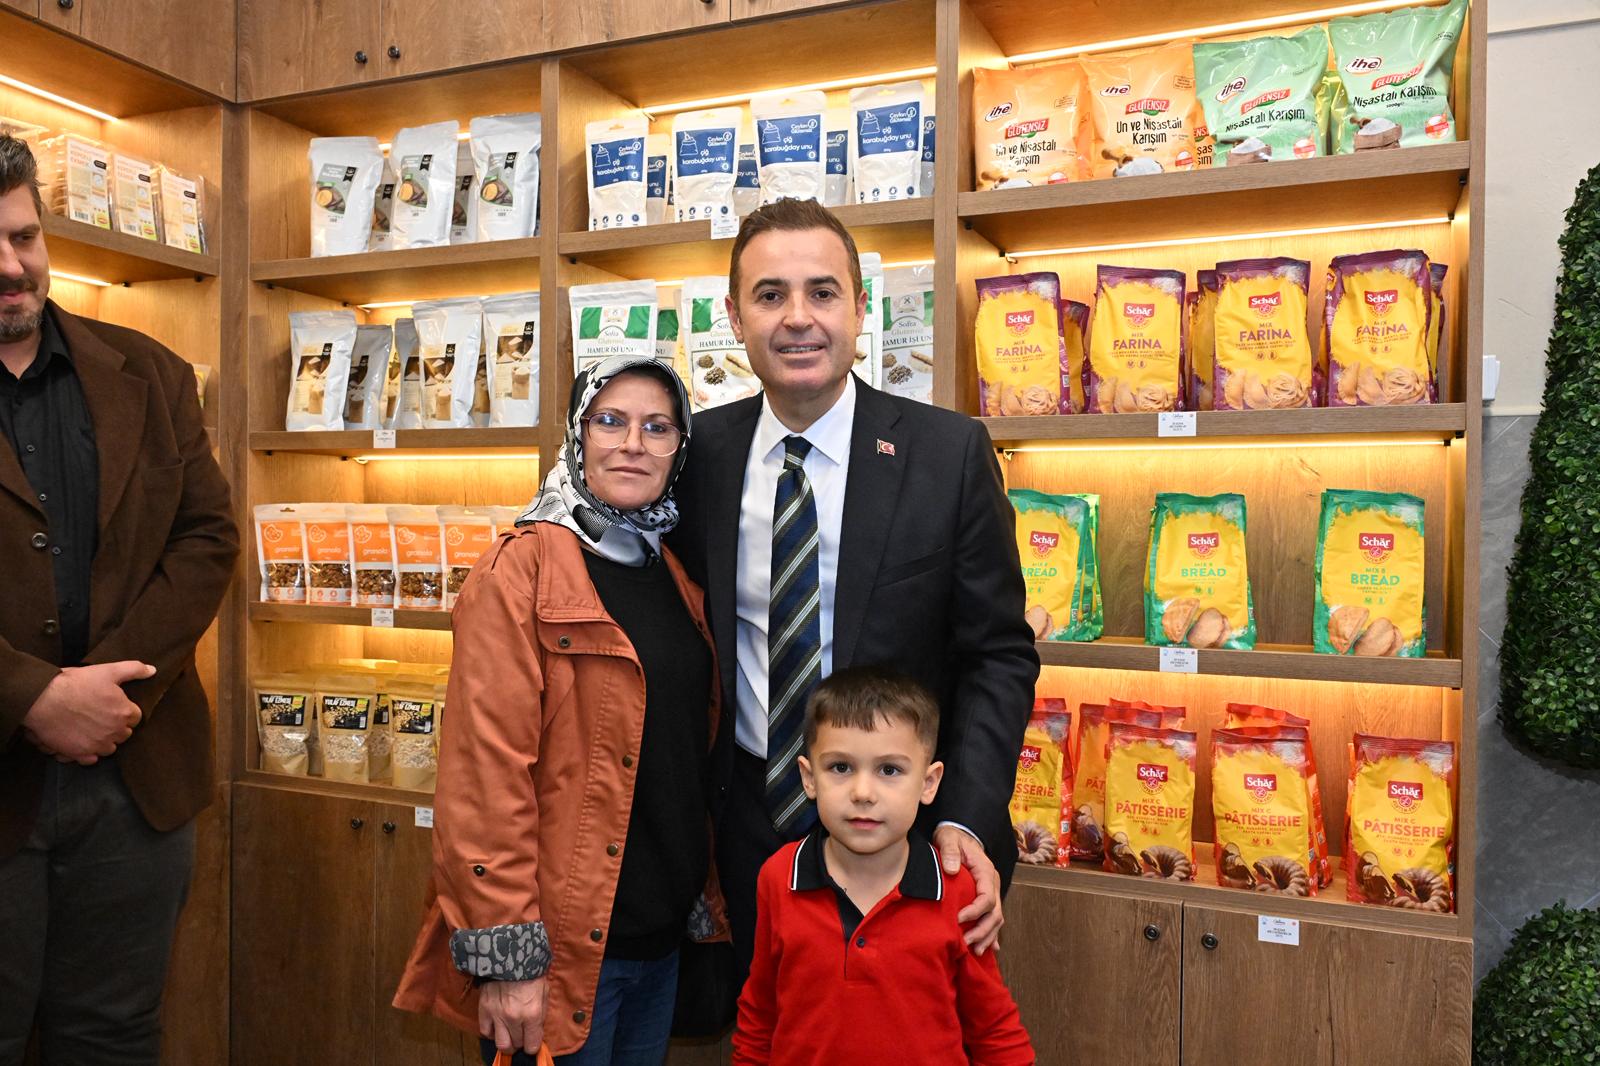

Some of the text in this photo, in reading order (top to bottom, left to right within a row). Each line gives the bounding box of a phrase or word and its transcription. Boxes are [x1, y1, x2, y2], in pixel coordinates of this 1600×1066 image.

[1352, 58, 1379, 69] ihe
[1220, 80, 1243, 96] ihe
[990, 105, 1010, 117] ihe
[1116, 120, 1128, 134] Un
[1130, 120, 1141, 131] ve
[1132, 132, 1167, 146] Karışım
[1008, 144, 1018, 154] ve
[1251, 296, 1279, 306] Schär
[1367, 293, 1395, 303] Schär
[1125, 305, 1152, 316] Schär
[1007, 313, 1033, 325] Schär
[1239, 328, 1292, 342] FARINA
[1356, 322, 1408, 337] FARINA
[699, 338, 724, 348] HAMUR
[1112, 338, 1162, 350] FARINA
[995, 344, 1042, 357] FARINA
[1032, 534, 1057, 546] Schär
[1191, 536, 1217, 546] Schär
[1361, 536, 1391, 549] Schär
[1181, 567, 1226, 577] BREAD
[1350, 574, 1400, 585] BREAD
[1139, 767, 1166, 779] Schär
[1246, 776, 1274, 789] Schär
[1390, 784, 1421, 798] Schär
